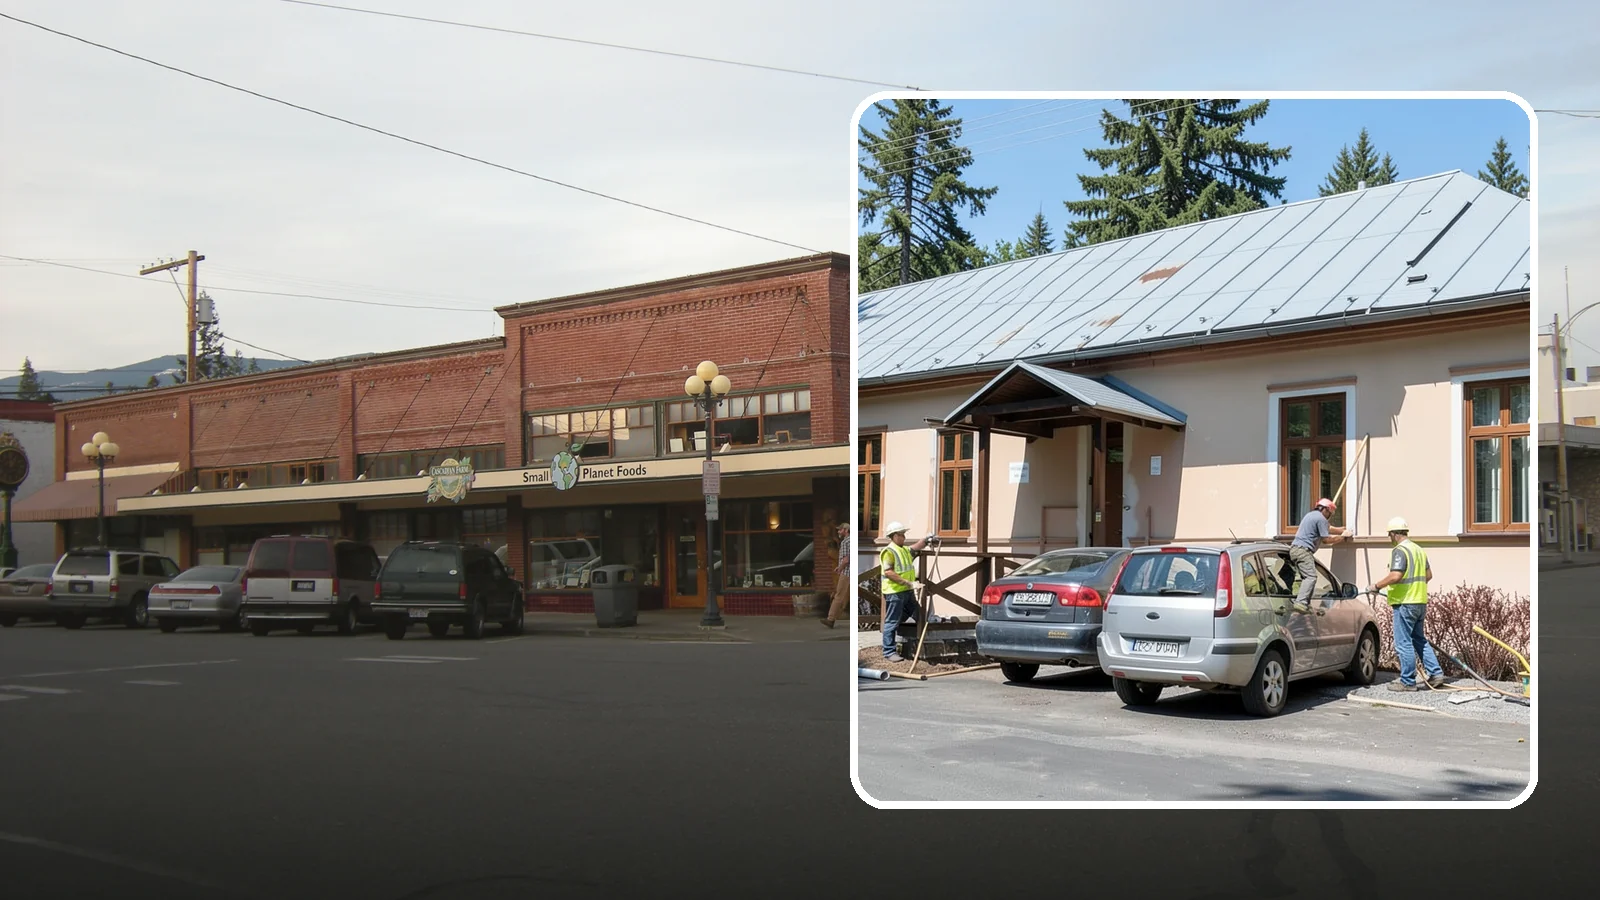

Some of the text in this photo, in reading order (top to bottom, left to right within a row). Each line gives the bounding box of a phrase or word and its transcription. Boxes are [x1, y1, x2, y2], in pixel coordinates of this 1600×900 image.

[523, 464, 647, 483] Small Planet Foods
